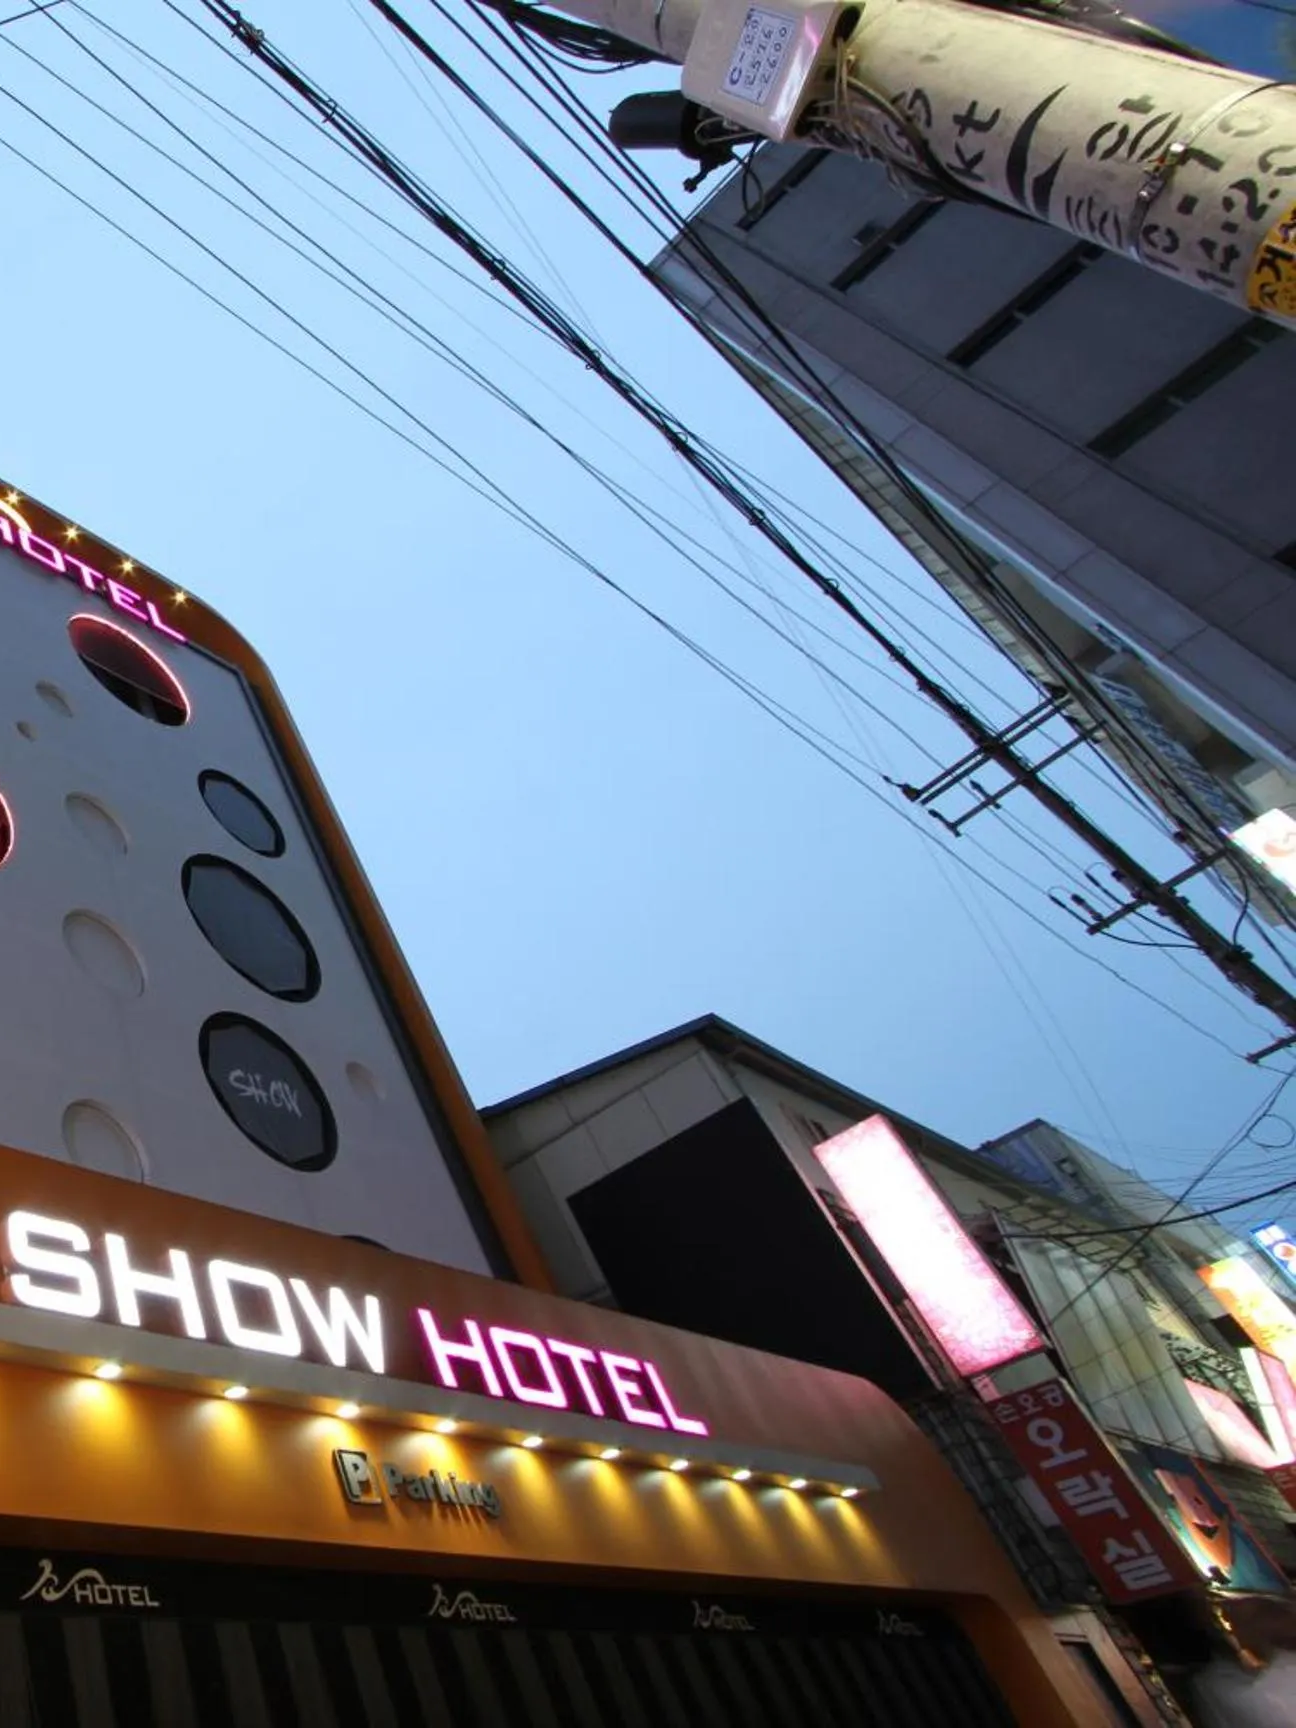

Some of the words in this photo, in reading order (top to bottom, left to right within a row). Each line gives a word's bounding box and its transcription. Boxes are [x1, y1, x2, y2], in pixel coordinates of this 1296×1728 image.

[946, 100, 1001, 182] kt
[6, 1209, 386, 1375] SHOW
[416, 1306, 710, 1437] HOTEL
[383, 1463, 501, 1519] Parking
[1026, 1416, 1174, 1591] 오락실
[74, 1582, 161, 1608] HOTEL
[458, 1600, 518, 1622] HOTEL
